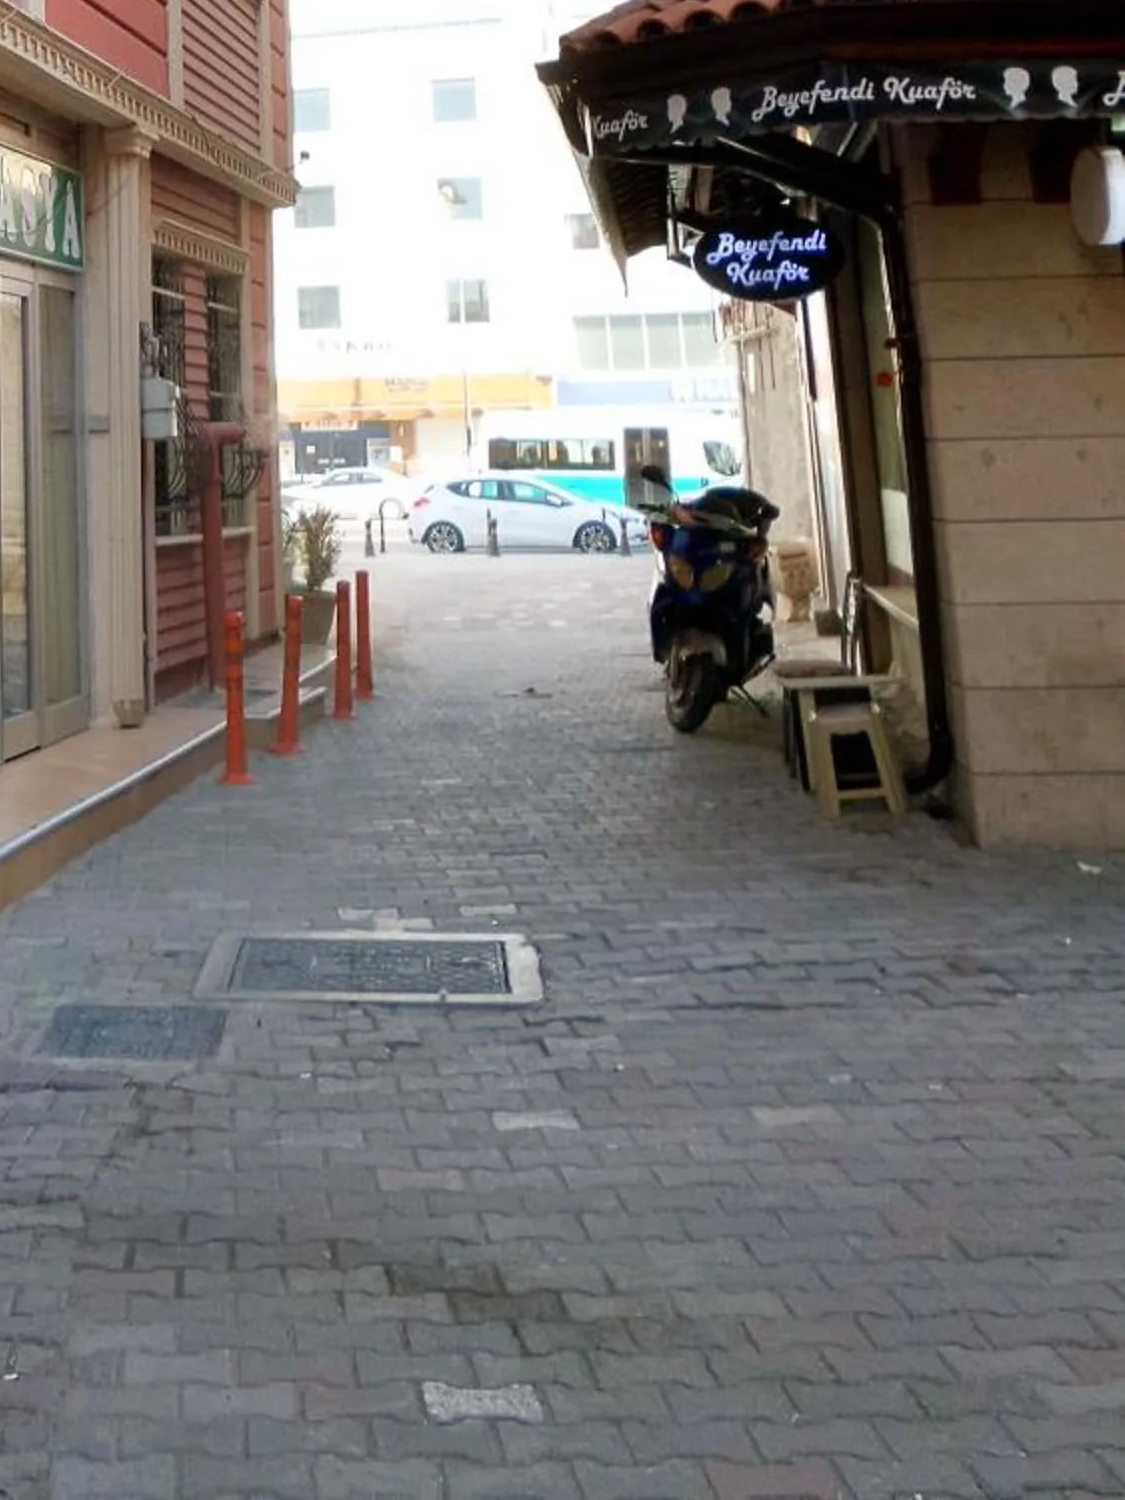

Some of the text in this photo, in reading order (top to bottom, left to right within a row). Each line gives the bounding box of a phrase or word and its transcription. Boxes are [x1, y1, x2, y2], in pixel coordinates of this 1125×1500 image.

[751, 76, 976, 122] Beyefendi Kuaför
[706, 229, 827, 265] Beyefendi
[726, 260, 810, 291] Kuaför
